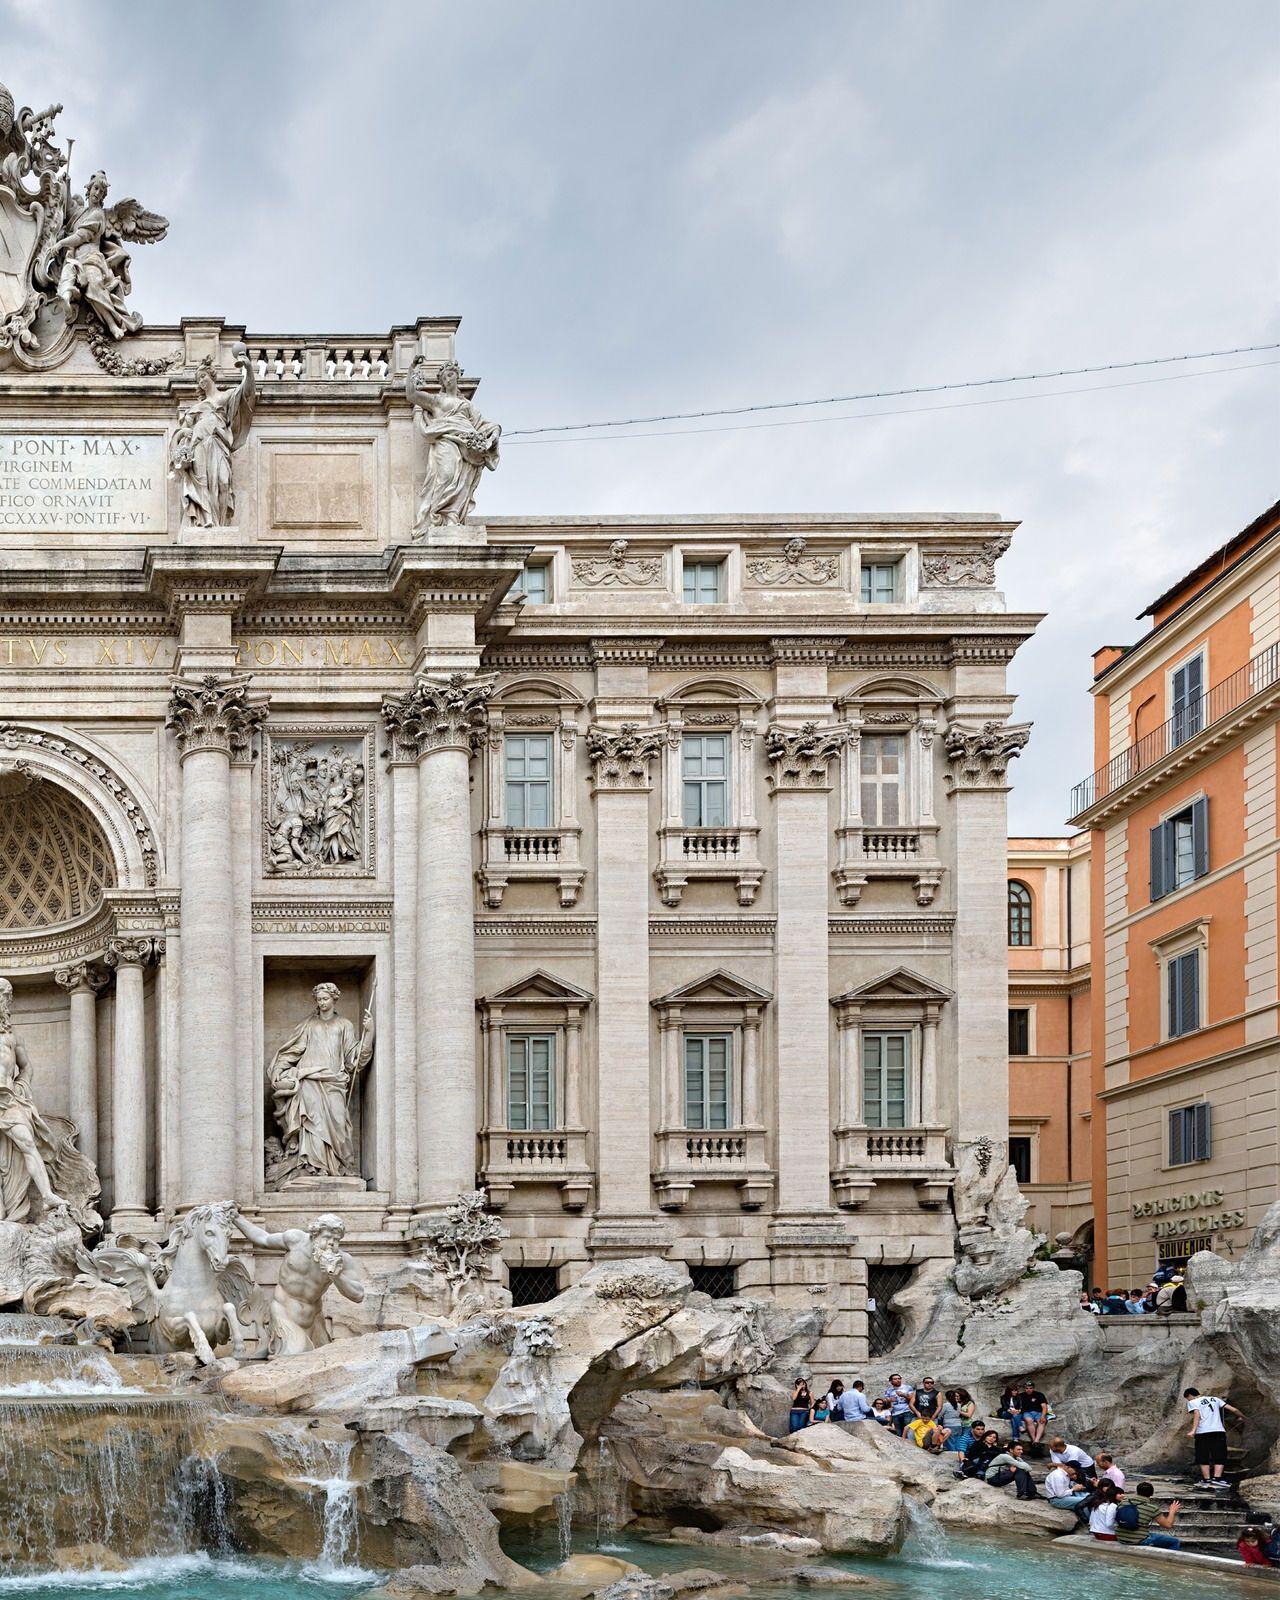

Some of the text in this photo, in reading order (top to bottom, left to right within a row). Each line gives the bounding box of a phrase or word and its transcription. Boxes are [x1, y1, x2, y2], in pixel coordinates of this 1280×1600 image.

[29, 478, 152, 490] COMMENDATAM
[42, 495, 114, 507] ORNAVIT
[1159, 1238, 1212, 1259] SOUVENIRS
[1208, 1403, 1215, 1413] 1
